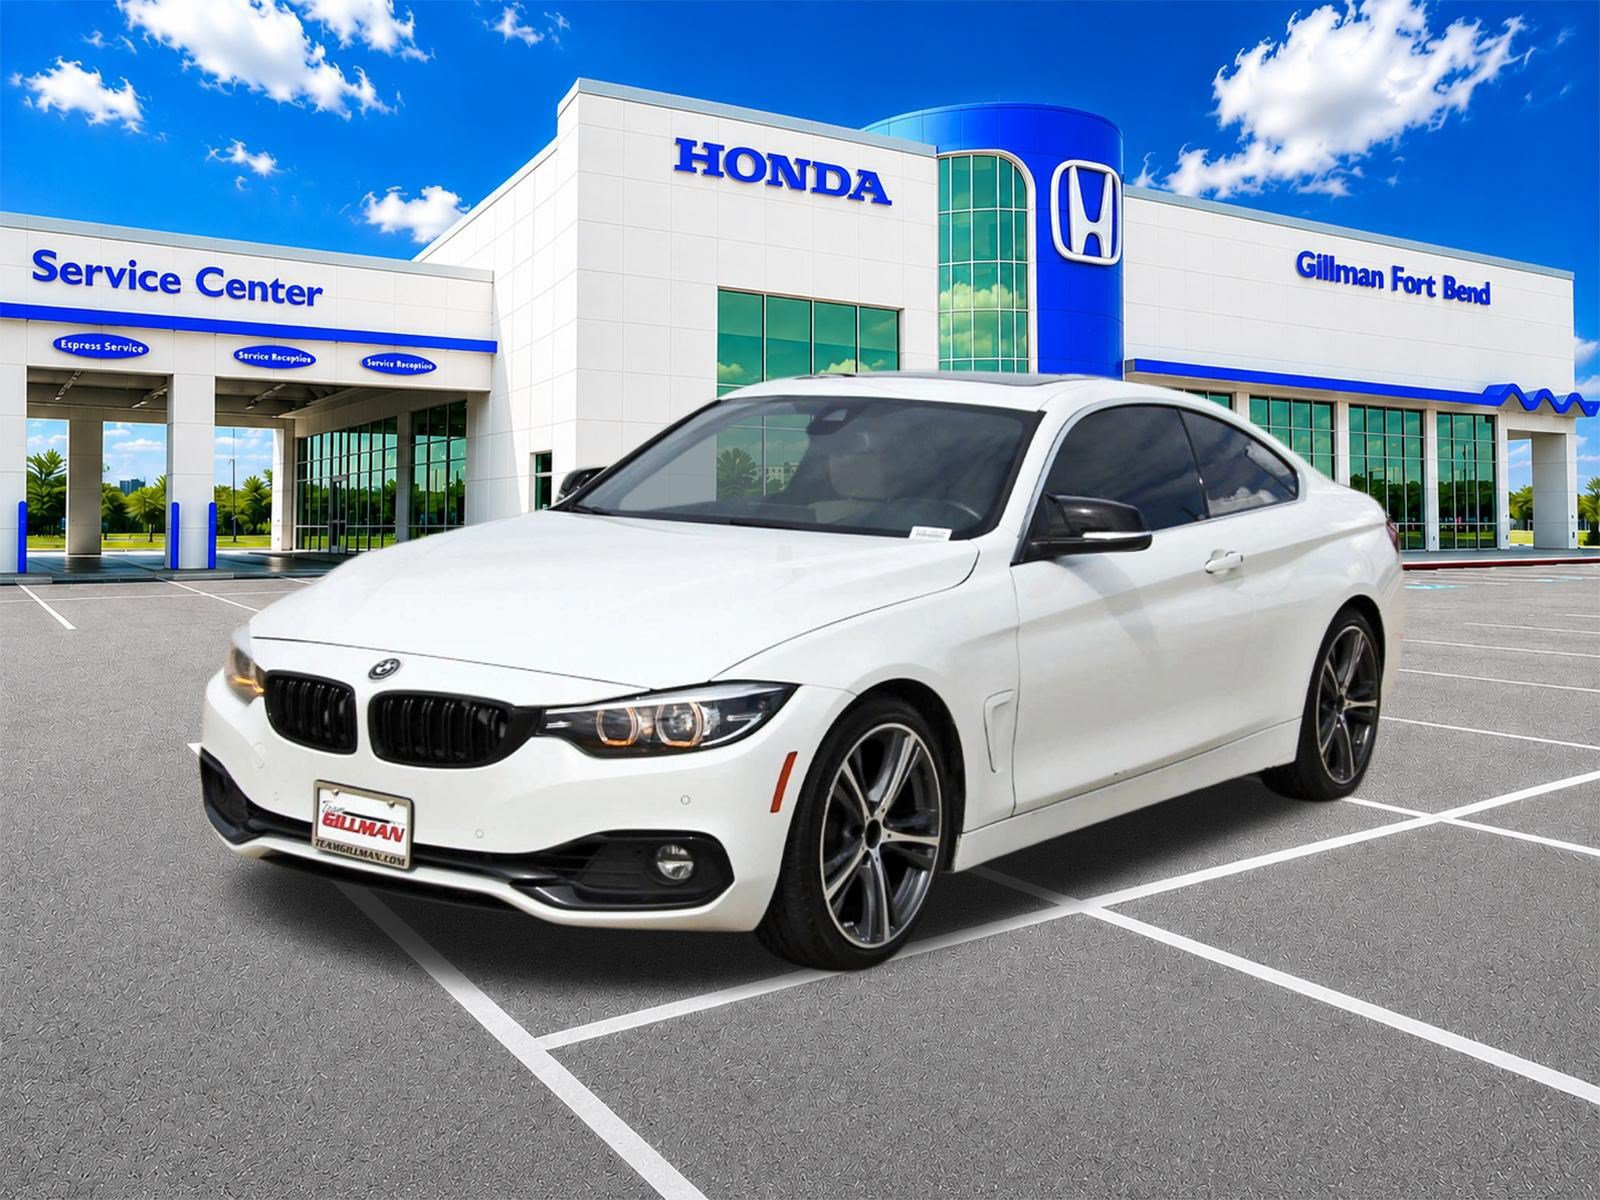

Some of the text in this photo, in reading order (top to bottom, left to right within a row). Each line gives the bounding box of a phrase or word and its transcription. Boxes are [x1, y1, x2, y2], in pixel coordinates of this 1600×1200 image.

[673, 137, 892, 206] HONDA
[32, 249, 324, 307] Service Center
[1296, 250, 1491, 305] Gillman Fort Bend
[104, 342, 144, 353] Service
[238, 351, 269, 361] Service
[366, 358, 394, 368] Service
[322, 812, 405, 842] GILLMAN
[315, 838, 405, 866] TEAMGILLMAN.COM
